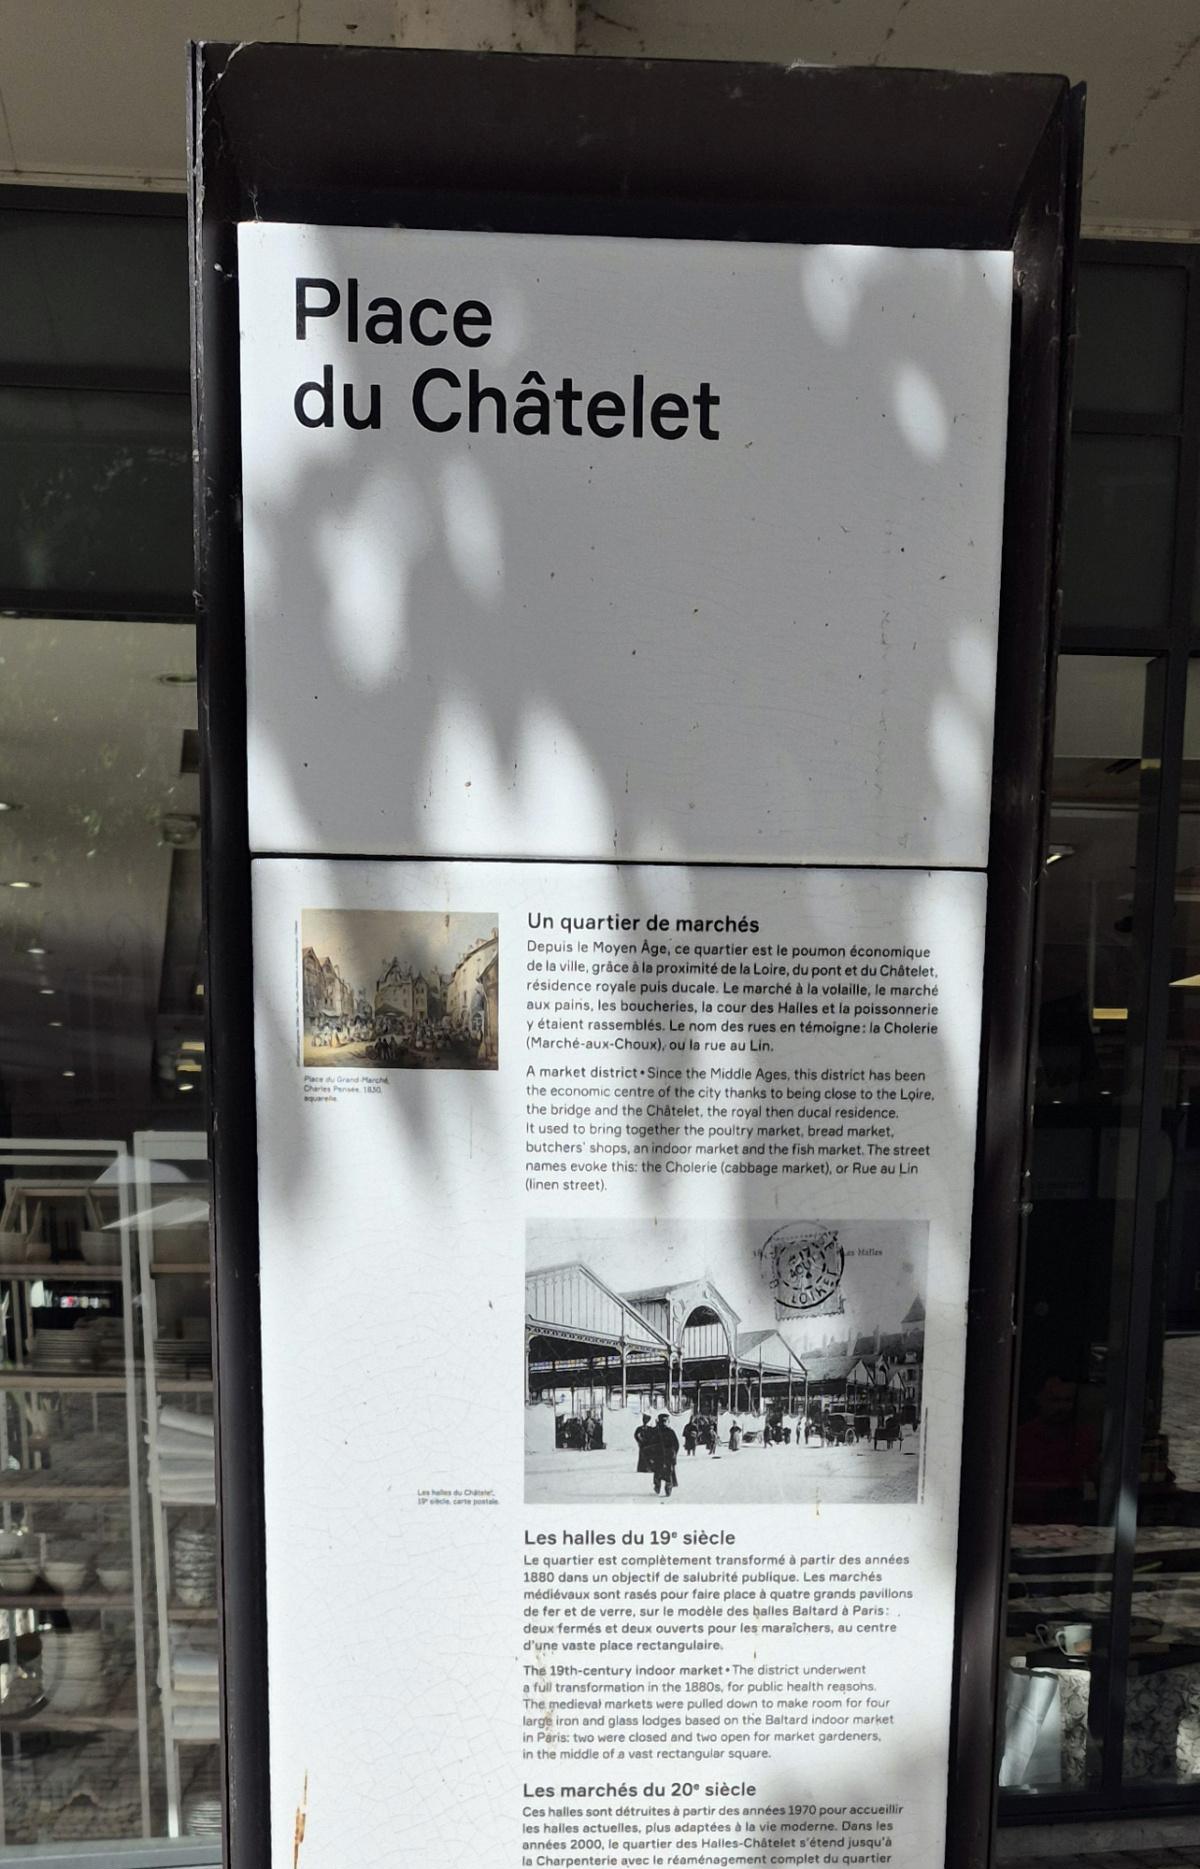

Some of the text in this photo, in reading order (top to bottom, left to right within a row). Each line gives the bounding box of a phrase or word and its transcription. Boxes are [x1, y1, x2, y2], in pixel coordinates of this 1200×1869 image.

[296, 277, 492, 348] Place
[294, 364, 720, 441] du Châtelet
[528, 912, 759, 934] Un quartier de marchés
[527, 939, 930, 960] Depuis le Moyen Âge, ce quartier est le poumon économique
[526, 998, 938, 1017] aux pains, les boucheries, la cour des Halles et la poissonnerie
[526, 1036, 773, 1051] (Marché-aux-Choux), ou la rue au Lin.
[525, 1065, 925, 1083] A market district Since the Middle Ages, this district has been
[524, 1530, 557, 1545] Les
[562, 1529, 616, 1545] halles
[621, 1529, 644, 1545] du
[682, 1530, 735, 1545] siècle
[523, 1553, 909, 1568] Le quartier est complètement transformé à partir des années
[522, 1664, 866, 1678] The 19th-century indoor market The district underwent
[523, 1783, 555, 1797] Les
[560, 1782, 638, 1797] marchés
[642, 1782, 665, 1796] du
[704, 1781, 756, 1796] siècle
[522, 1836, 892, 1851] années 2000, le quartier des Halles-Châtelet s'étend jusqu'à
